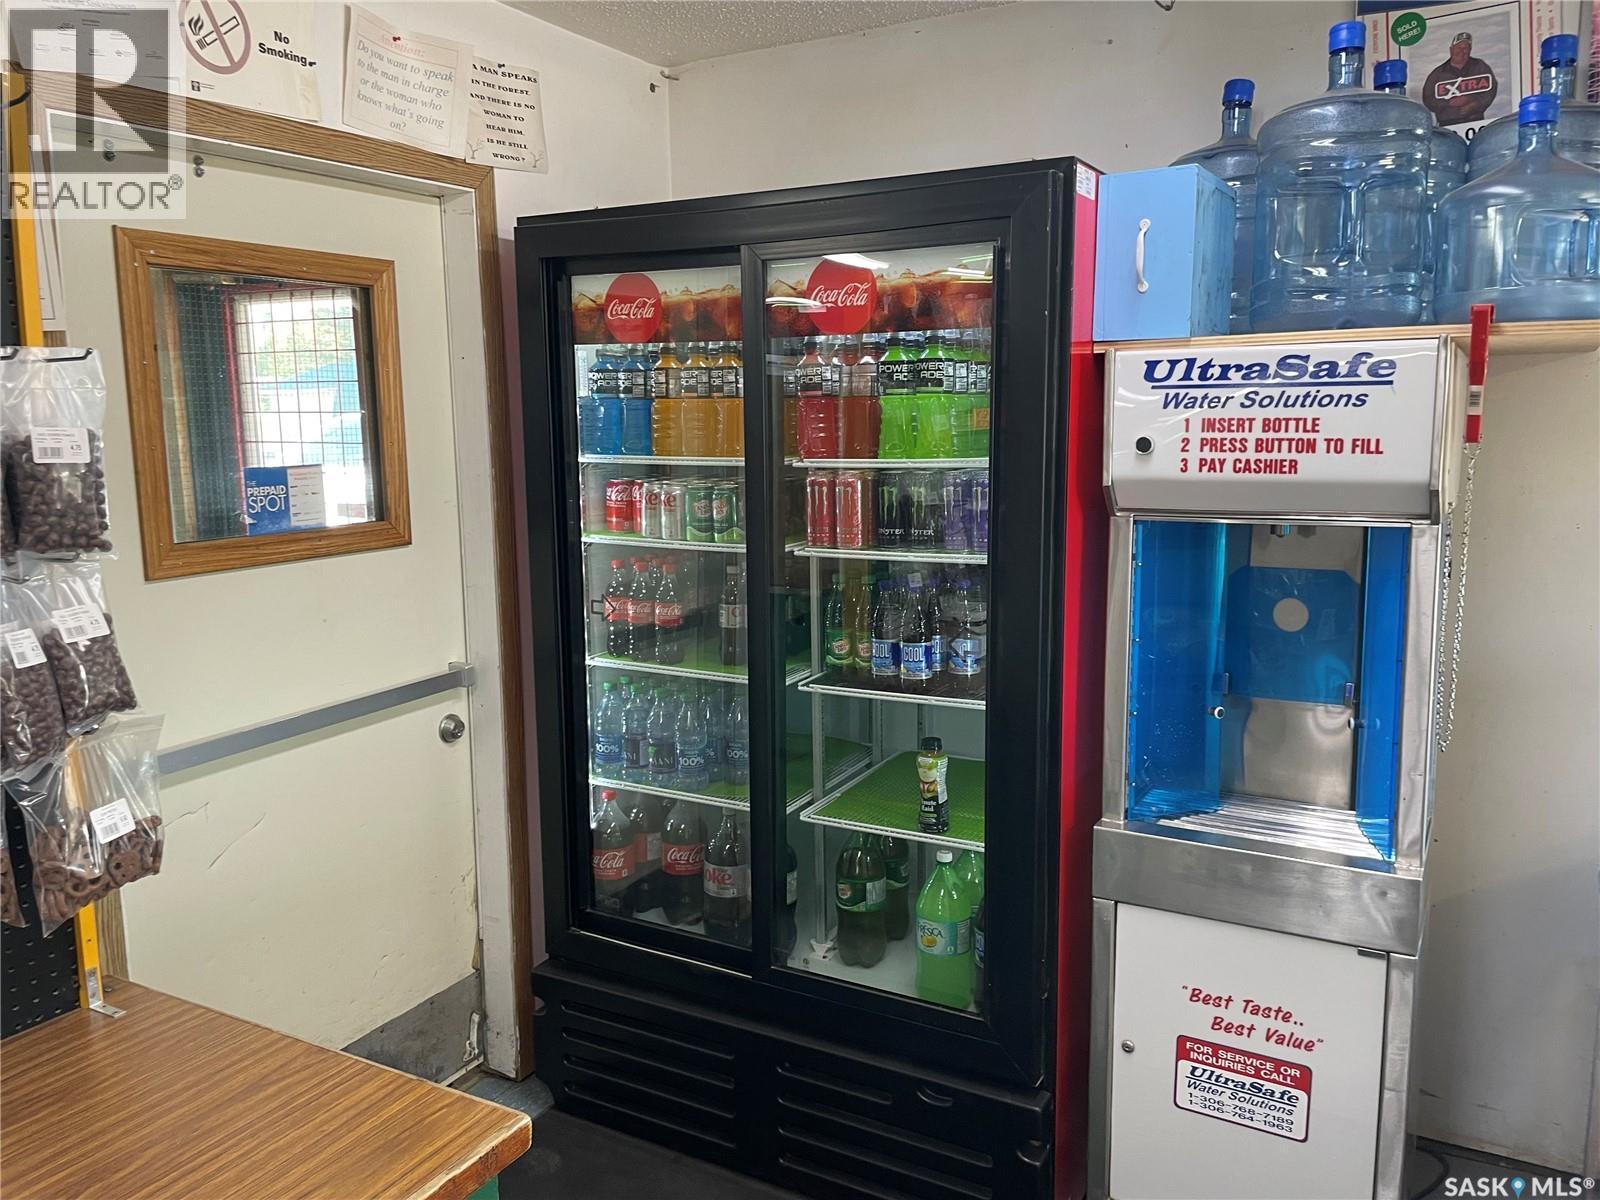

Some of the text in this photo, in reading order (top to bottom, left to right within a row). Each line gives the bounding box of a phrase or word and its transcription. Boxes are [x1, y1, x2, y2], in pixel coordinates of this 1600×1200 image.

[1397, 20, 1417, 34] SOLD
[274, 30, 290, 45] No
[258, 43, 308, 68] Smoking
[357, 40, 454, 83] Do you want to speak
[366, 62, 379, 76] the
[380, 70, 399, 84] man
[401, 78, 410, 88] in
[412, 81, 450, 98] charge
[472, 78, 480, 86] IN
[482, 81, 496, 90] THE
[480, 65, 498, 76] MAN
[501, 71, 538, 84] SPEAKS
[360, 78, 442, 111] or the woman who
[1438, 77, 1488, 98] EXTRA
[470, 92, 486, 100] AND
[486, 96, 512, 106] THERE
[357, 90, 382, 108] knows
[416, 114, 444, 129] going
[484, 109, 512, 120] WOMAN
[390, 122, 407, 130] on?
[486, 124, 506, 132] HEAR
[508, 142, 528, 150] STILL
[810, 282, 872, 308] Coca-Cola
[607, 297, 656, 320] Coca-Cola
[879, 364, 914, 373] POWER
[1142, 352, 1397, 383] UltraSafe
[1162, 390, 1369, 410] Water Solutions
[1184, 417, 1320, 434] 1 INSERT BOTTLE
[1180, 438, 1384, 455] 2 PRESS BUTTON TO FILL
[1180, 458, 1298, 475] 3 PAY CASHIER
[247, 484, 286, 497] PREPAID
[248, 494, 286, 514] SPOT
[904, 644, 924, 662] COOL
[1210, 1016, 1257, 1039] Best
[1186, 1041, 1300, 1078] FOR SERVICE OR
[1190, 1050, 1296, 1086] INQUIRIES CALL
[1189, 1064, 1300, 1104] UltraSafe
[1187, 1080, 1295, 1116] Water Solutions
[1188, 1092, 1294, 1126] 1-306-768-7189
[1188, 1100, 1294, 1133] 1-306-764-1963
